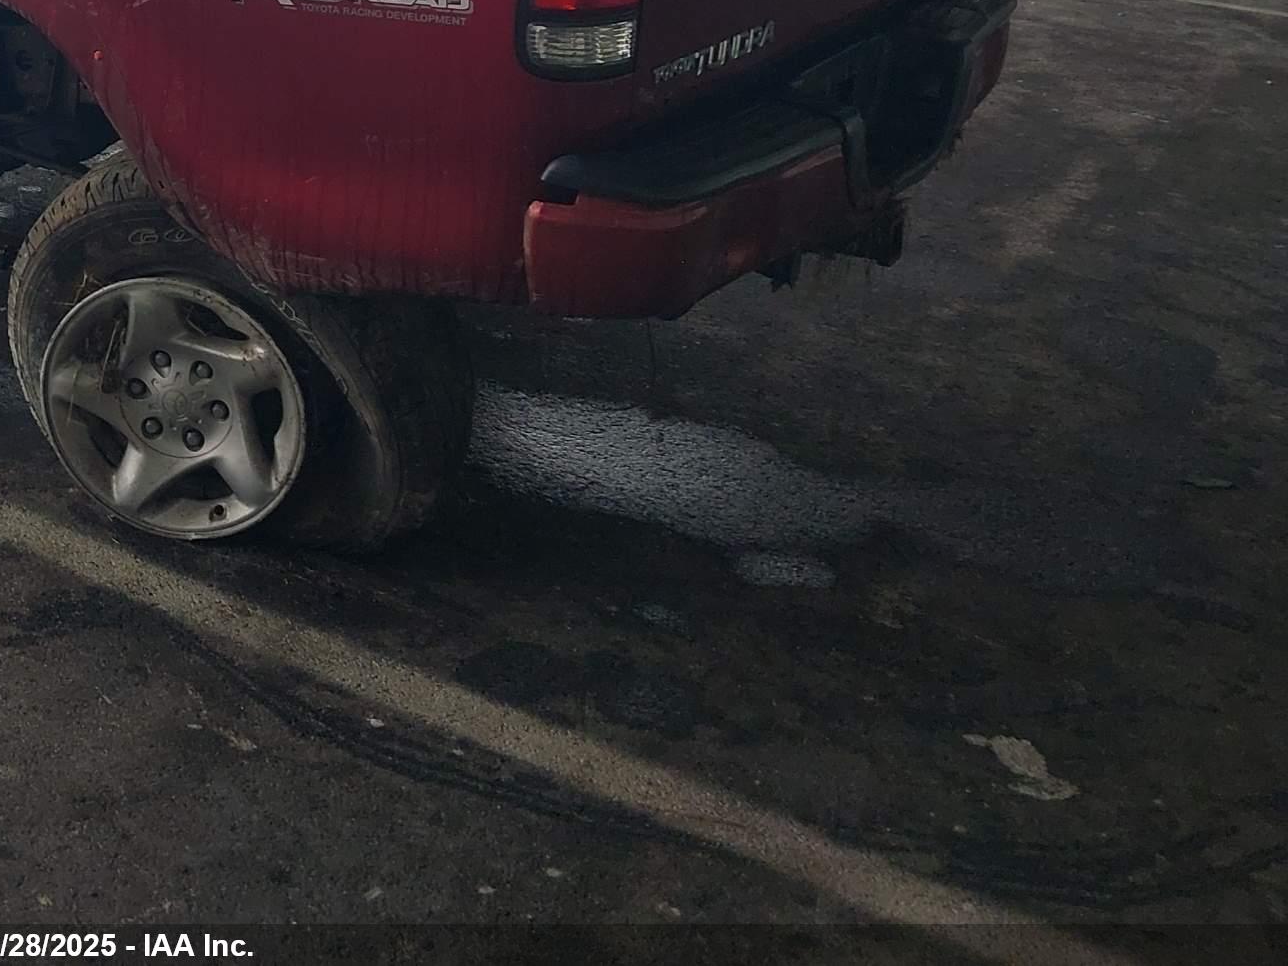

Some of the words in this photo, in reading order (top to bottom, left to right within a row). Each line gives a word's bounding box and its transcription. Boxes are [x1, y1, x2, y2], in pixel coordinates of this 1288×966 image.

[300, 2, 341, 15] TOYOTA
[342, 6, 384, 20] RACING
[385, 10, 468, 27] DEVELOPMENT
